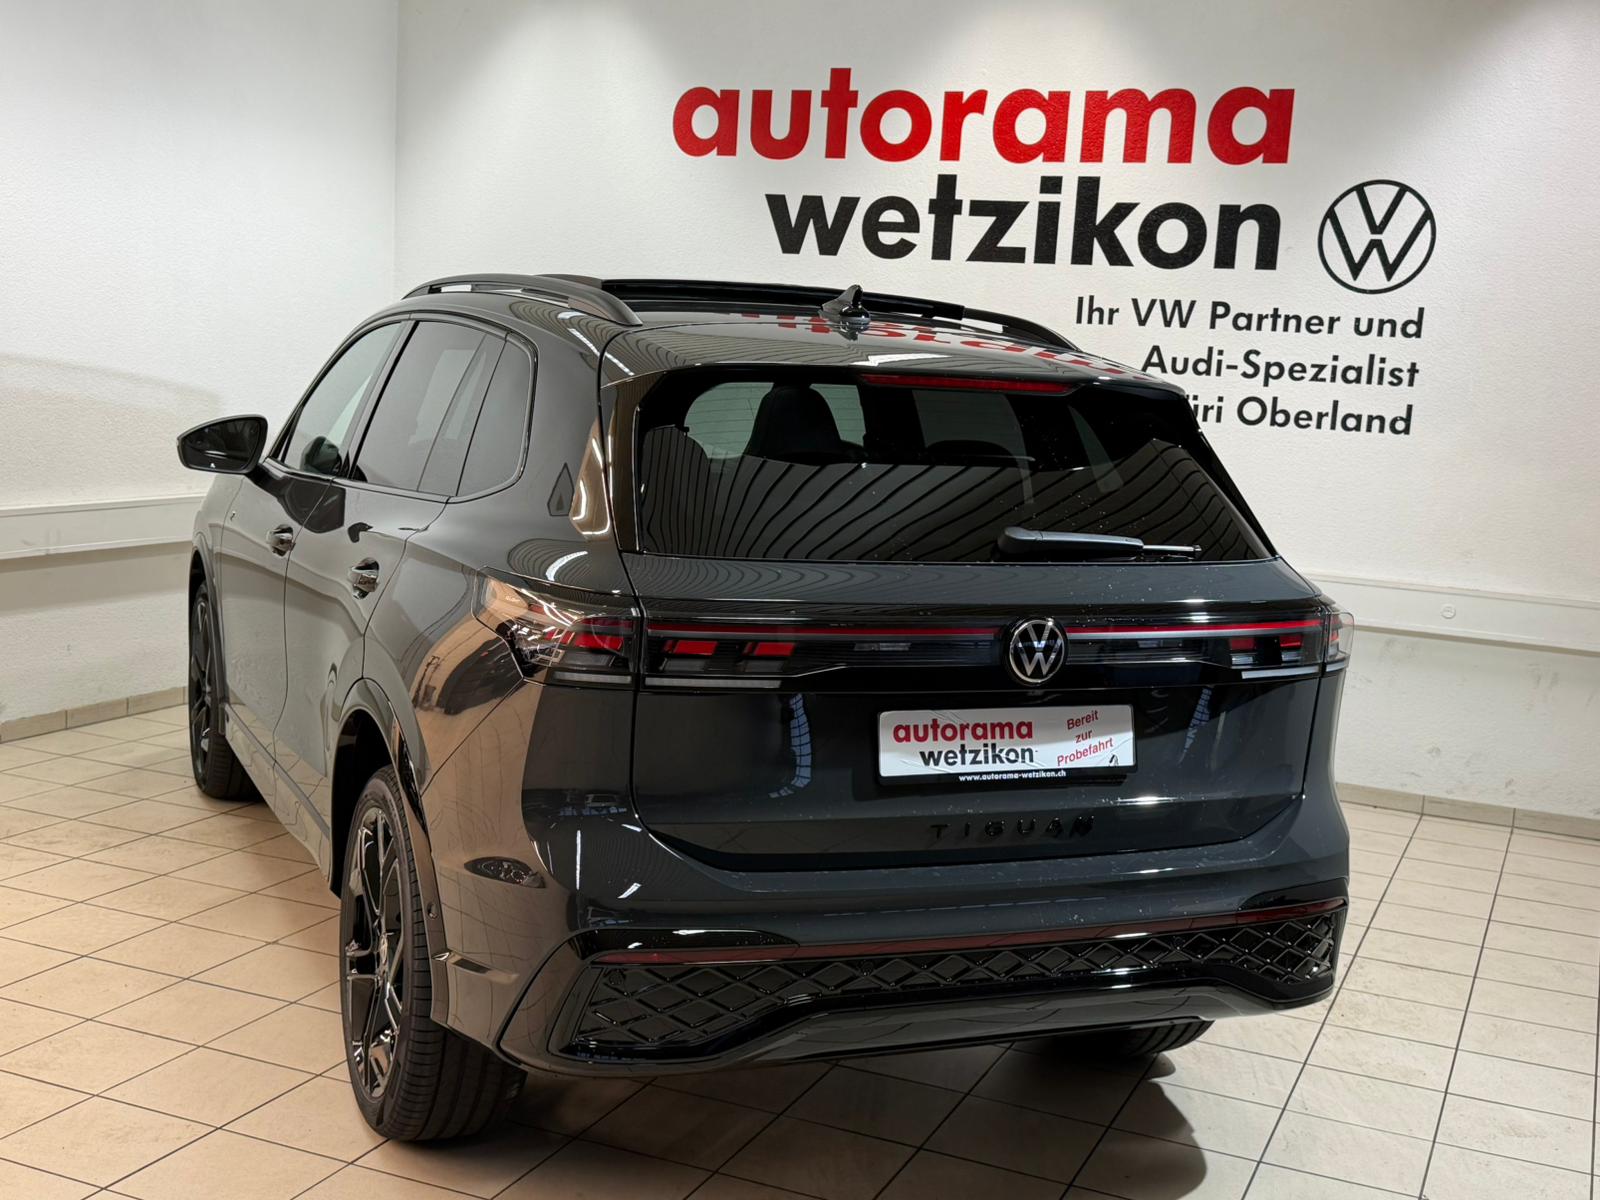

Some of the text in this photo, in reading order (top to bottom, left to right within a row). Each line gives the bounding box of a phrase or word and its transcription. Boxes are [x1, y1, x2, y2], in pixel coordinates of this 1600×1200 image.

[673, 67, 1295, 166] autorama
[764, 173, 1281, 271] wetzikon
[1318, 179, 1437, 295] VW
[1076, 294, 1425, 339] Ihr VW Partner und
[1140, 345, 1420, 388] Audi-Spezialist
[1237, 396, 1413, 436] Oberland
[893, 718, 1033, 743] autorama
[1066, 710, 1099, 730] Bereit
[1057, 737, 1114, 766] Probefahrt
[1075, 730, 1093, 744] zur
[919, 743, 1034, 767] wetzikon
[958, 769, 1067, 782] www.autorama-wetzikon.ch
[930, 815, 1095, 840] TIGUAN
